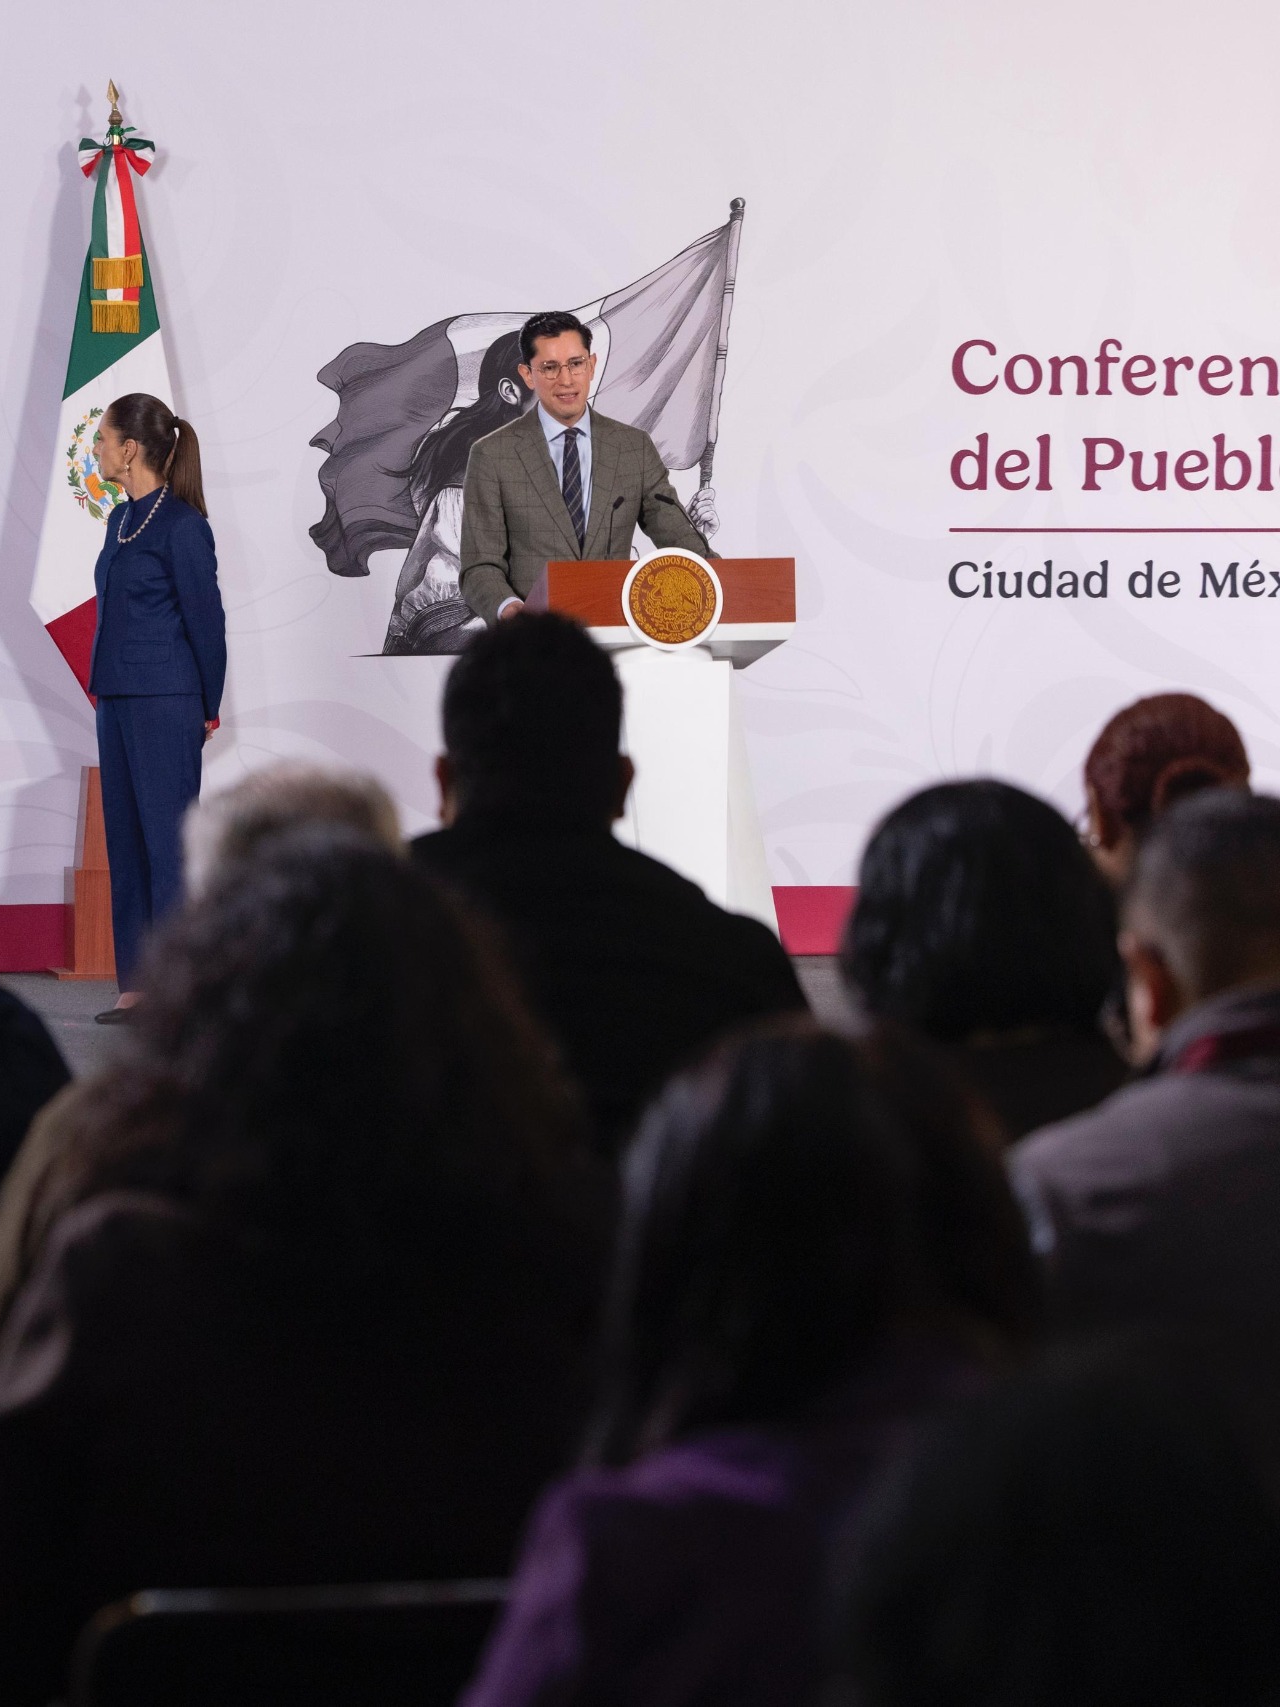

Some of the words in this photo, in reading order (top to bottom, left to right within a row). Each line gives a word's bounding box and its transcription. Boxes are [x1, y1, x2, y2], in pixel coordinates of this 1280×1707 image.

[951, 338, 1280, 397] Conferen
[949, 431, 1054, 492] del
[1080, 432, 1280, 492] Puebl
[630, 565, 653, 601] ESTADOS
[650, 556, 681, 570] UNIDOS
[681, 556, 715, 600] MEXICANOS
[947, 559, 1109, 599] Ciudad
[1127, 559, 1181, 599] de
